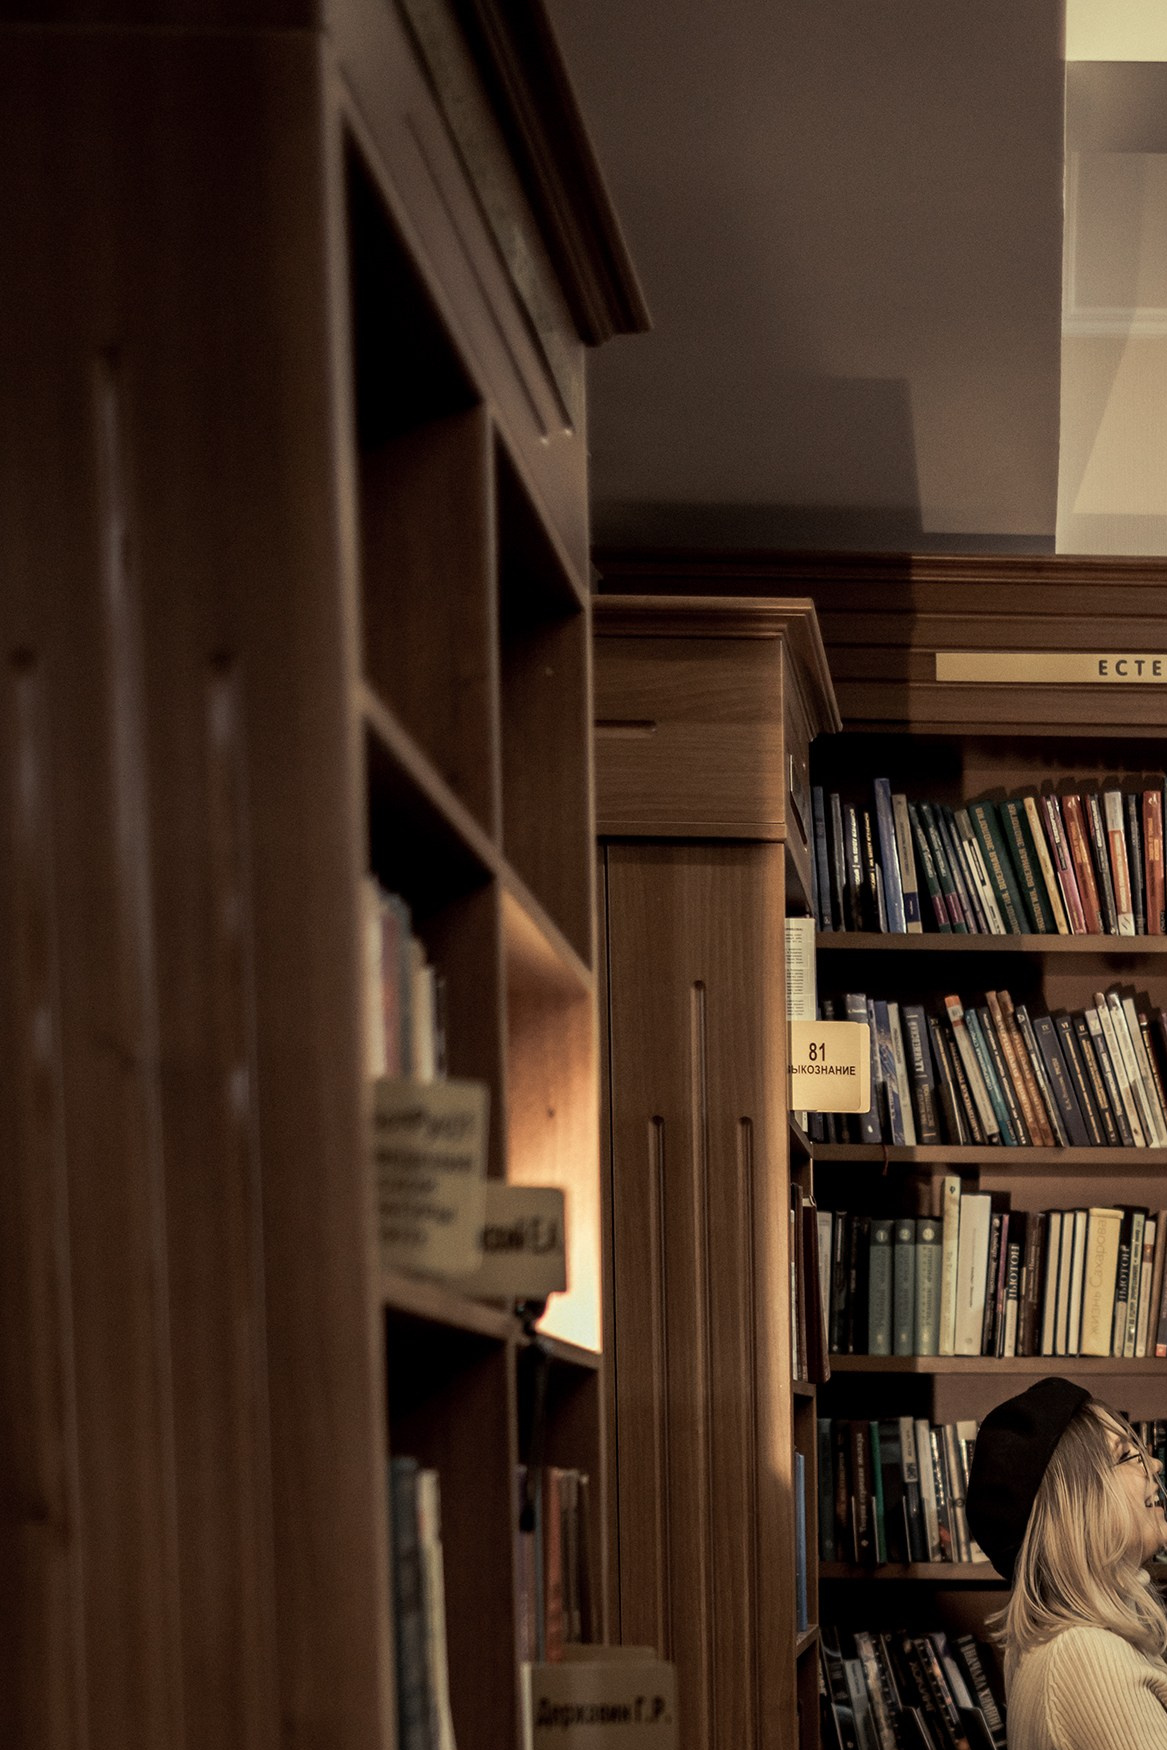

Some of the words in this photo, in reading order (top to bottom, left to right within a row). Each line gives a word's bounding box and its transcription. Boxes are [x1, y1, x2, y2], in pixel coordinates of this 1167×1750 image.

[974, 806, 995, 851] ЭКОЛОГИЯ
[1006, 803, 1025, 847] ЭКОЛОГИЯ
[988, 851, 1007, 890] ВОЕННАЯ
[1018, 847, 1035, 887] ВОЕННАЯ
[809, 1042, 825, 1061] 81
[1089, 1218, 1107, 1288] Сахарова
[1089, 1290, 1100, 1334] жизнь
